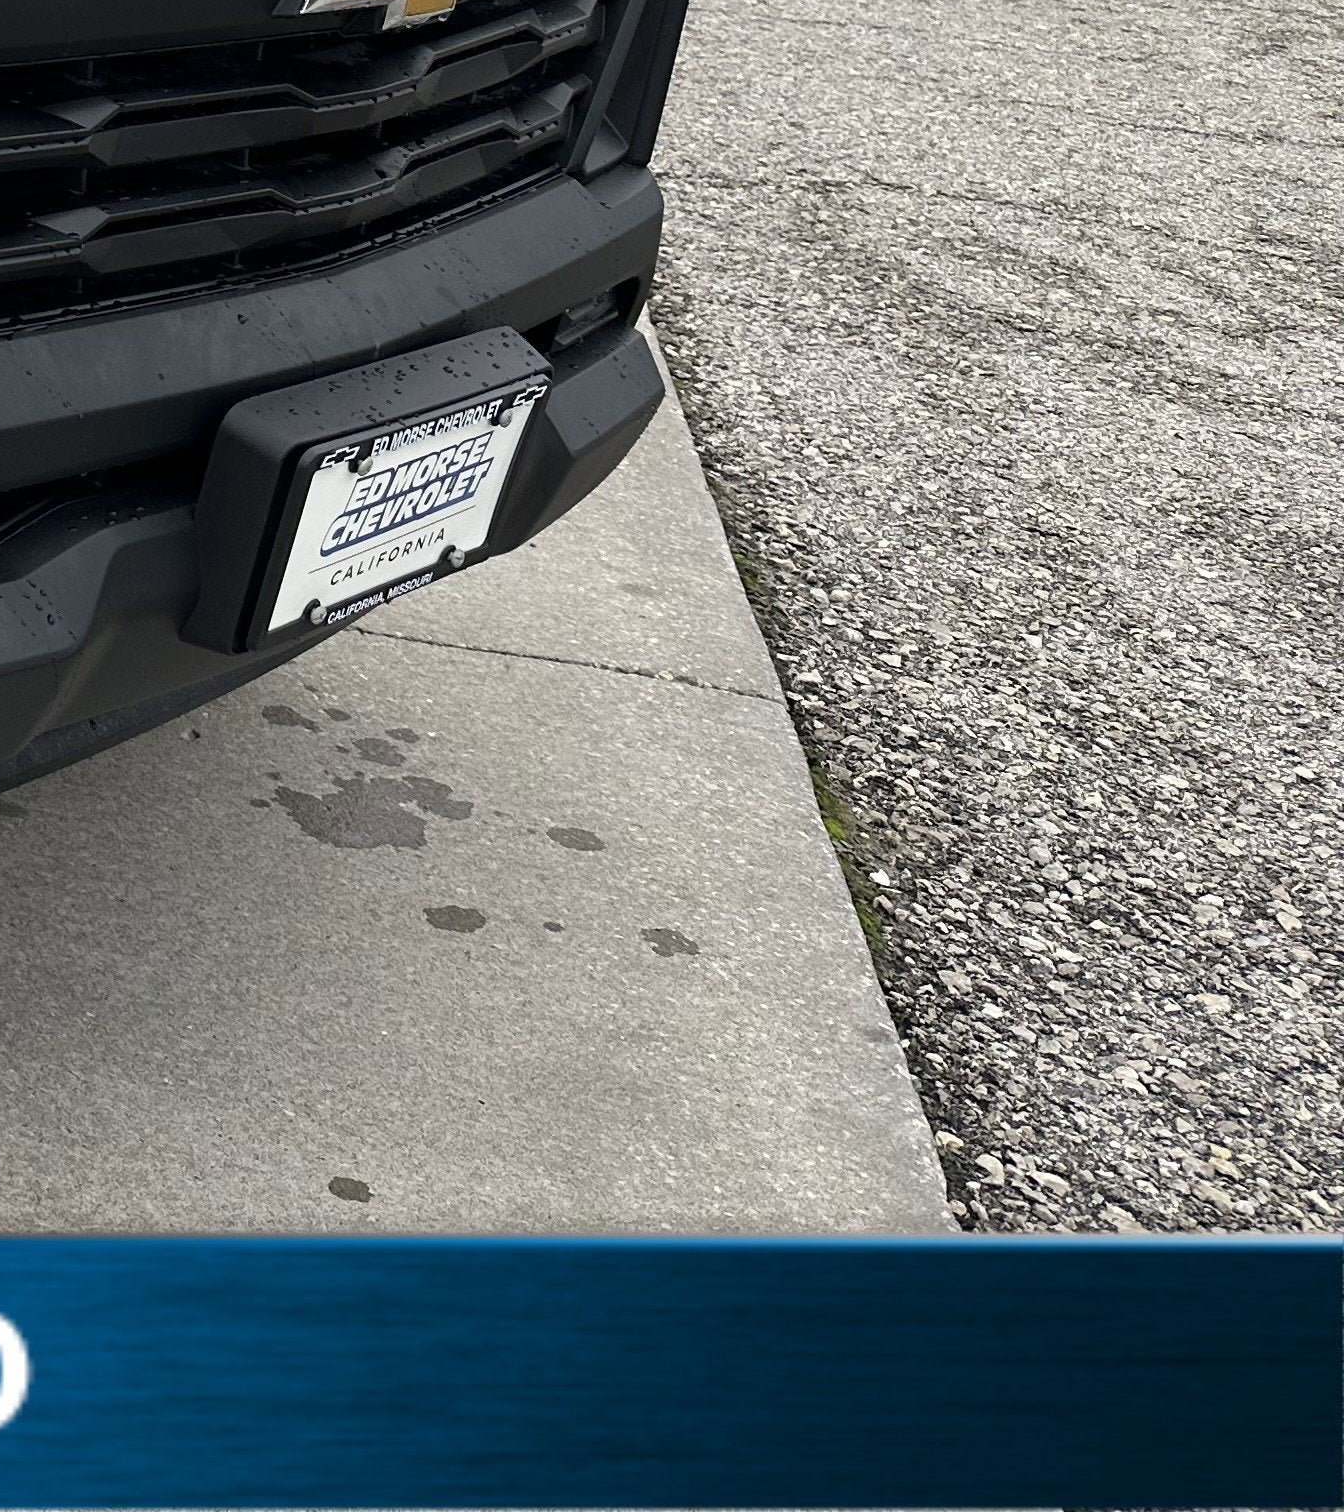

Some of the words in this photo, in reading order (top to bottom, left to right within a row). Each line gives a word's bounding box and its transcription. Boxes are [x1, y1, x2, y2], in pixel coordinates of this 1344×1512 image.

[371, 436, 390, 457] ED
[389, 421, 436, 452] MORSE
[434, 399, 504, 437] CHEVROLET
[343, 467, 396, 515] ED
[387, 431, 495, 499] MORSE
[320, 457, 495, 558] CHEVROLET
[330, 528, 445, 586] CALIFORNIA
[327, 592, 385, 625] CALIFORNIA,
[387, 572, 434, 599] MISSOURI
